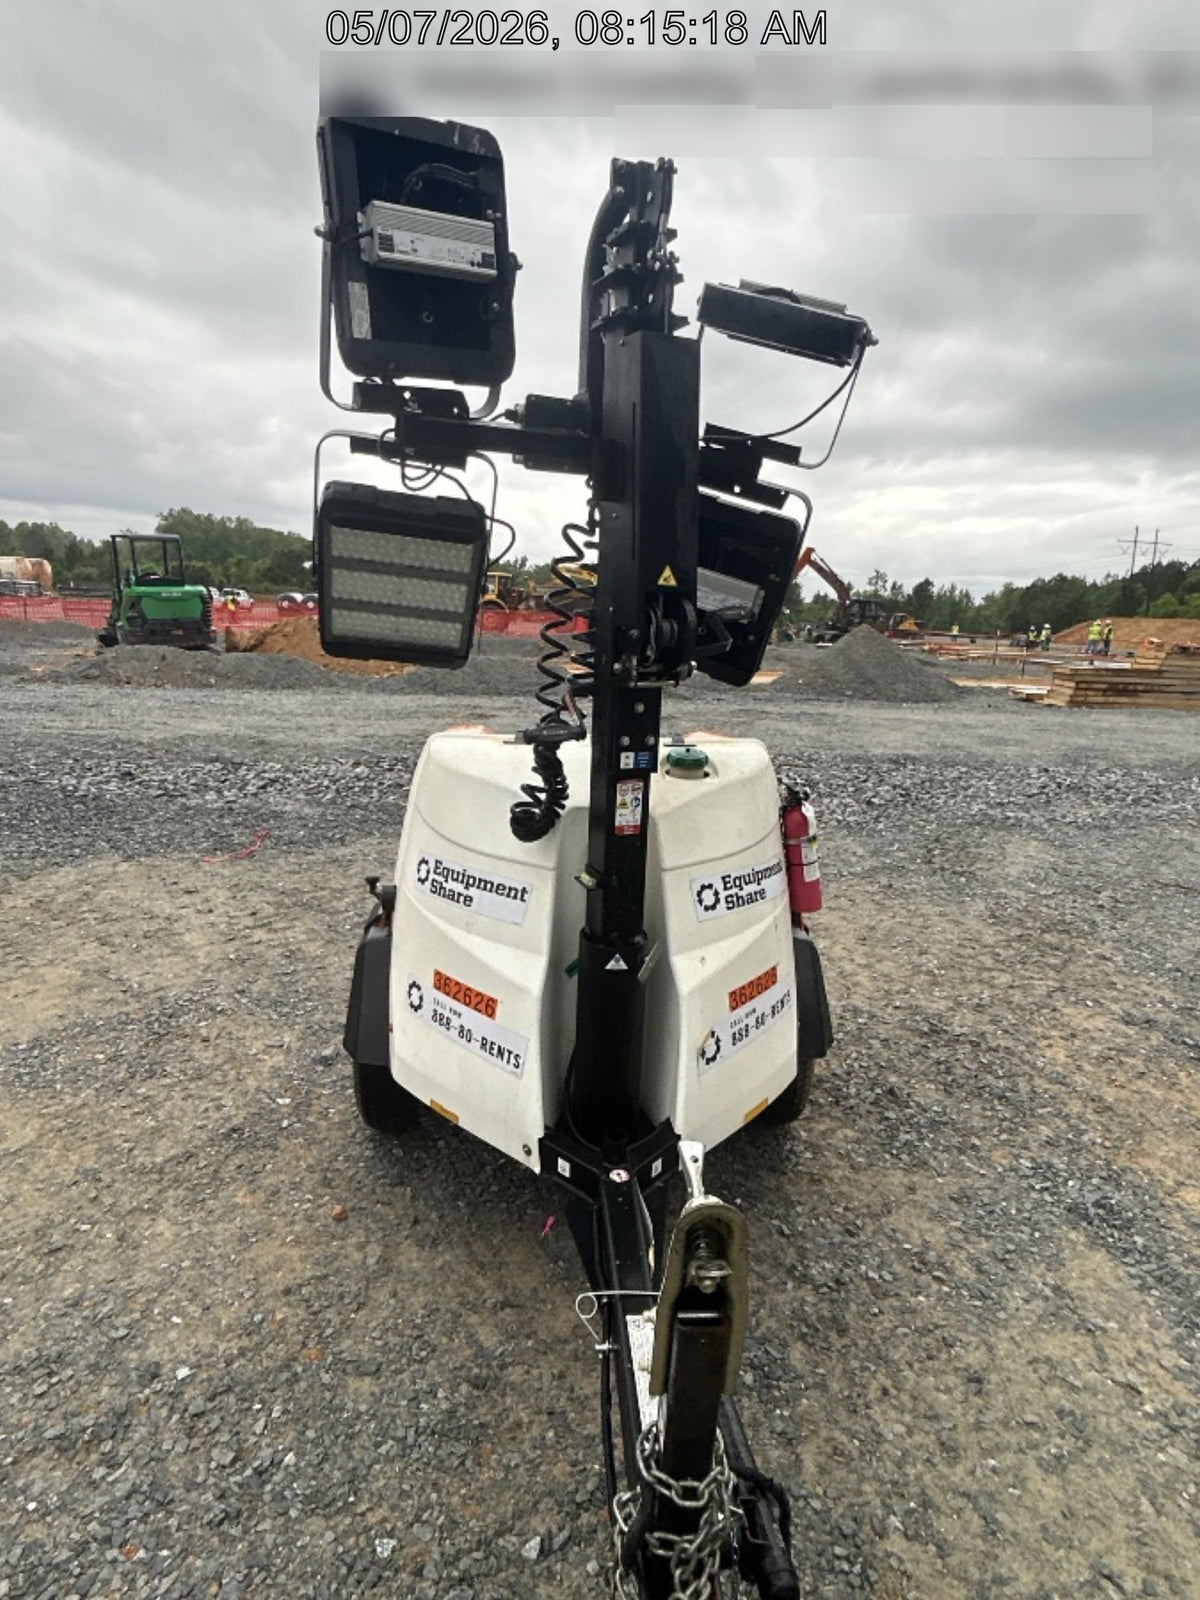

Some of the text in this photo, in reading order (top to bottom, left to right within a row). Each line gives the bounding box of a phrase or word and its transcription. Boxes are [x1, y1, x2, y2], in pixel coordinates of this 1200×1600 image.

[429, 878, 474, 907] Share
[433, 859, 529, 903] Equipment
[724, 888, 767, 911] Share
[434, 970, 496, 1018] 362626
[431, 1008, 522, 1070] 888-80-RENTS
